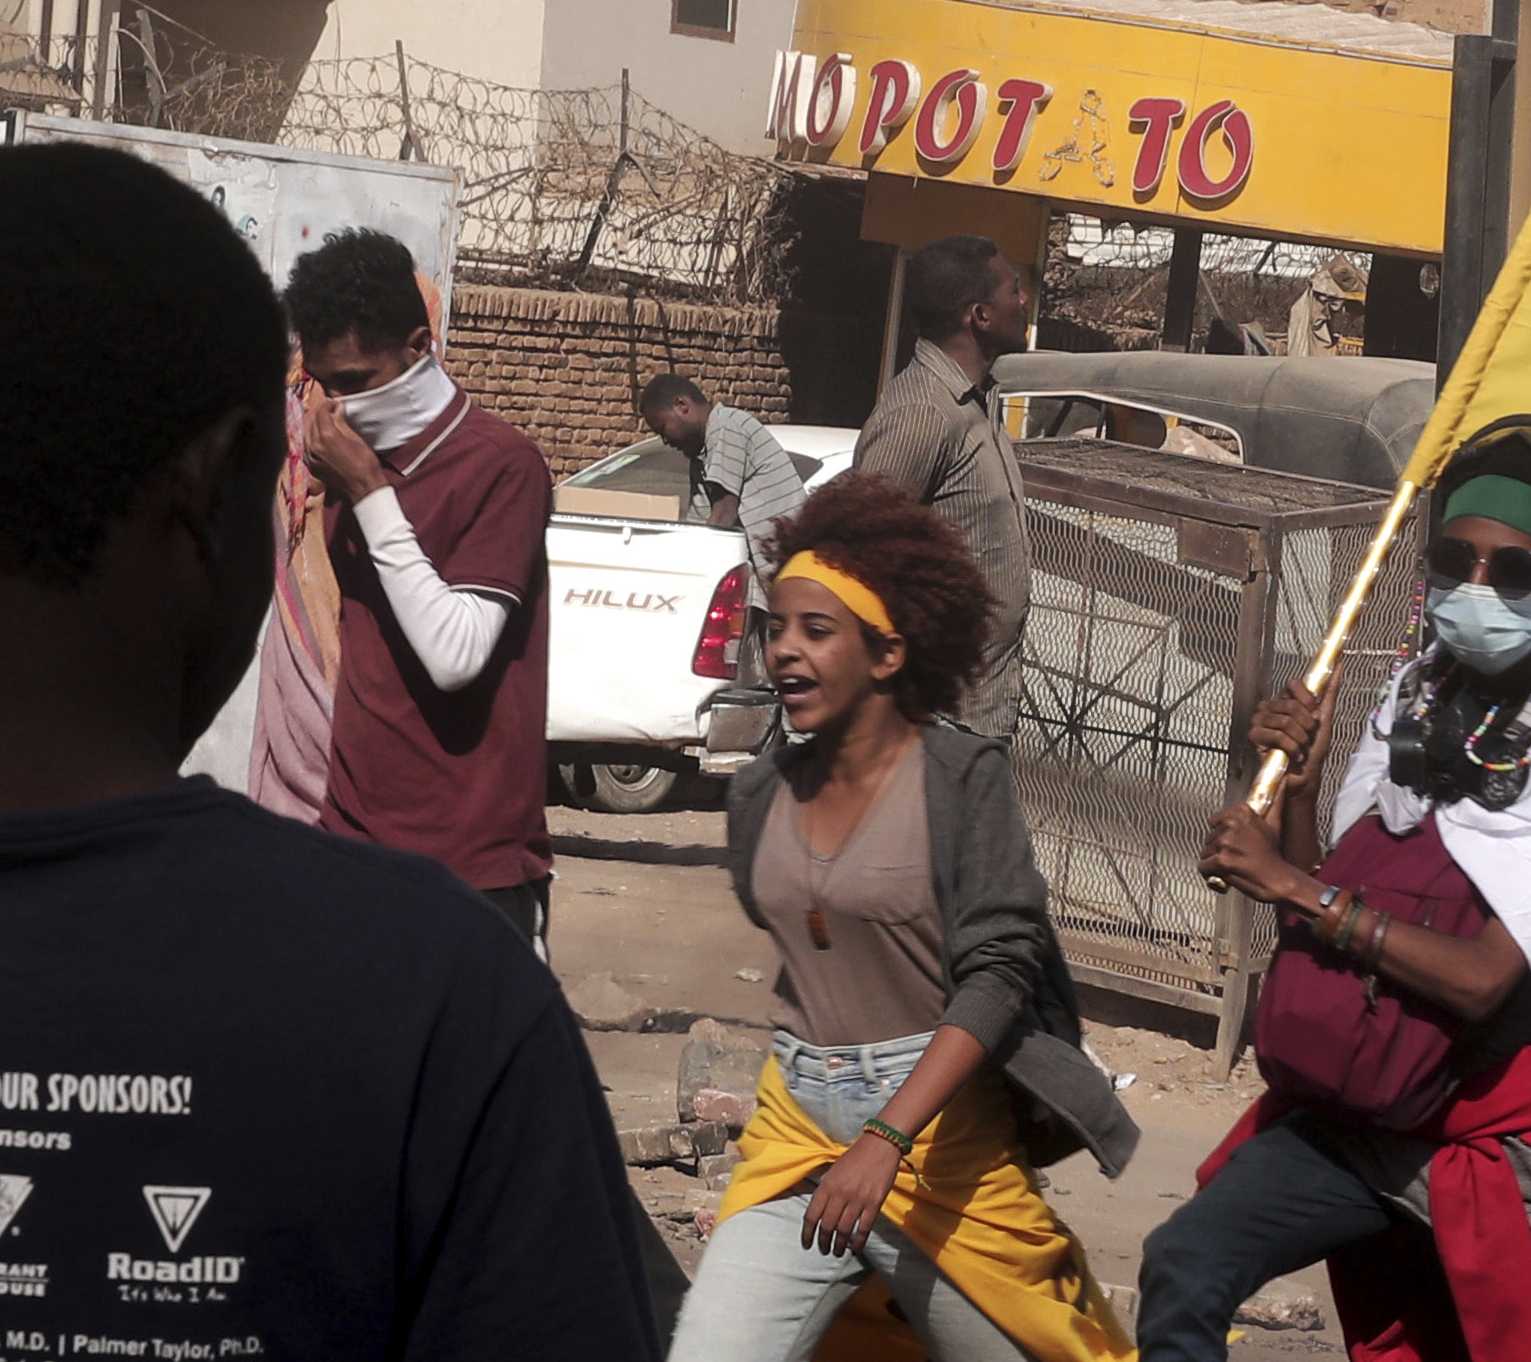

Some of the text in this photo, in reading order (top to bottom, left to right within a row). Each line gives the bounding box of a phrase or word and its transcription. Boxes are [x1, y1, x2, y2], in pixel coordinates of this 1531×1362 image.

[564, 587, 686, 614] HILUX
[47, 1073, 193, 1115] SPONSORS!
[107, 1252, 240, 1284] RoadID
[6, 1330, 50, 1351] M.D.
[73, 1335, 146, 1356] Palmer
[151, 1338, 216, 1362] Taylor,
[219, 1336, 264, 1357] Ph.D.
